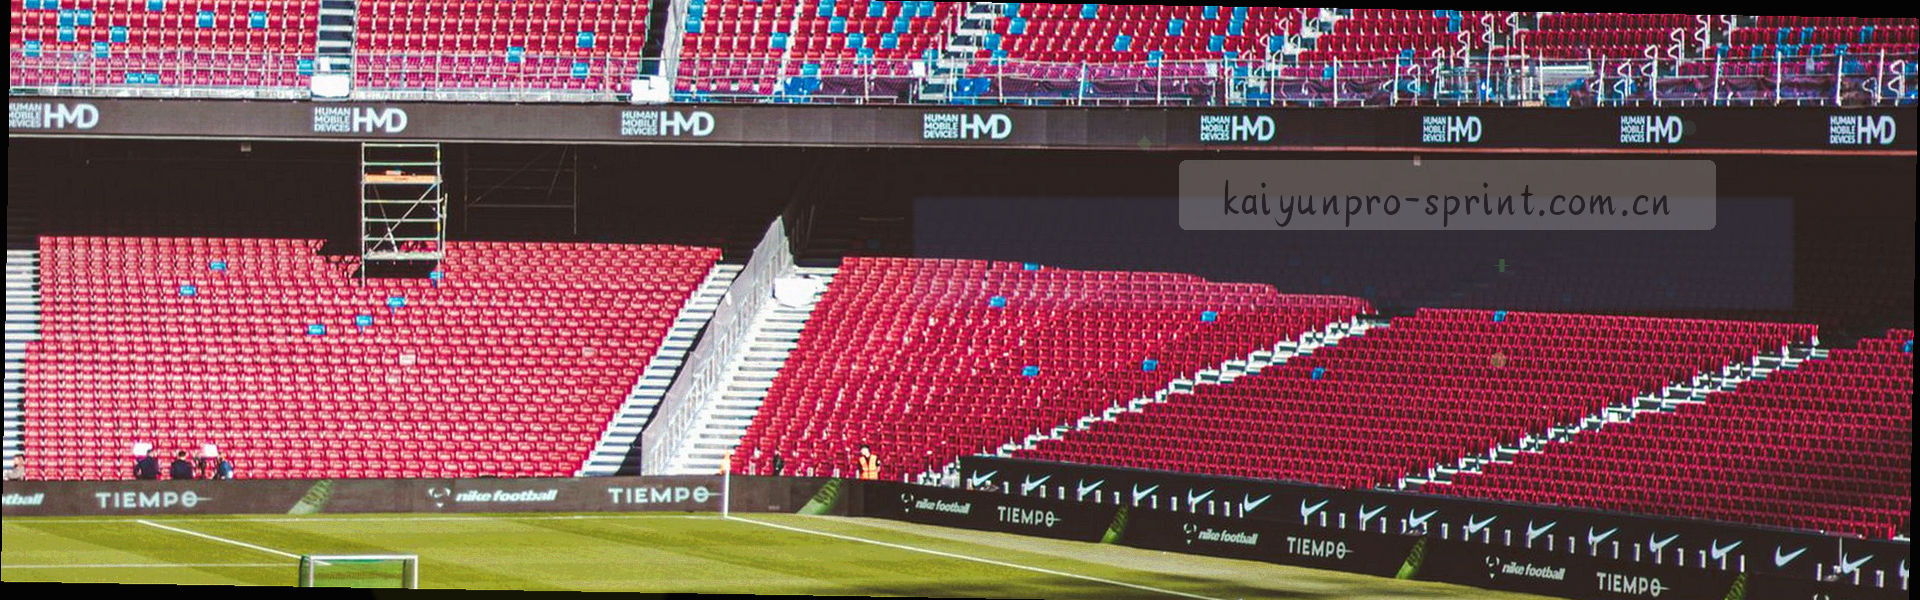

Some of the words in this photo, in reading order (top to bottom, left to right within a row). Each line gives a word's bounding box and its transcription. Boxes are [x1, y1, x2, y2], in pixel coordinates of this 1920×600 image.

[44, 103, 99, 129] HMD
[315, 106, 351, 116] HUMAN
[315, 115, 351, 124] MOBILE
[353, 107, 407, 133] HMD
[622, 111, 658, 119] HUMAN
[924, 114, 959, 122] HUMAN
[315, 123, 351, 132] DEVICES
[622, 119, 658, 128] MOBILE
[622, 127, 658, 136] DEVICES
[660, 111, 715, 136] HMD
[924, 122, 959, 130] MOBILE
[961, 114, 1012, 139] HMD
[1231, 115, 1275, 141] HMD
[1447, 116, 1482, 143] HMD
[1646, 116, 1683, 143] HMD
[1857, 116, 1896, 144] HMD
[924, 130, 959, 139] DEVICES
[95, 490, 200, 509] TIEMPO
[455, 489, 492, 502] nike
[493, 489, 558, 502] football
[607, 486, 710, 503] TIEMPO
[915, 498, 935, 511] nike
[935, 499, 971, 515] football
[997, 506, 1055, 527] TIEMPO
[1198, 528, 1221, 541] nike
[1220, 529, 1259, 545] football
[1287, 537, 1346, 559] TIEMPO
[1502, 561, 1525, 575] nike
[1525, 562, 1566, 580] football
[1597, 572, 1661, 597] TIEMPO
